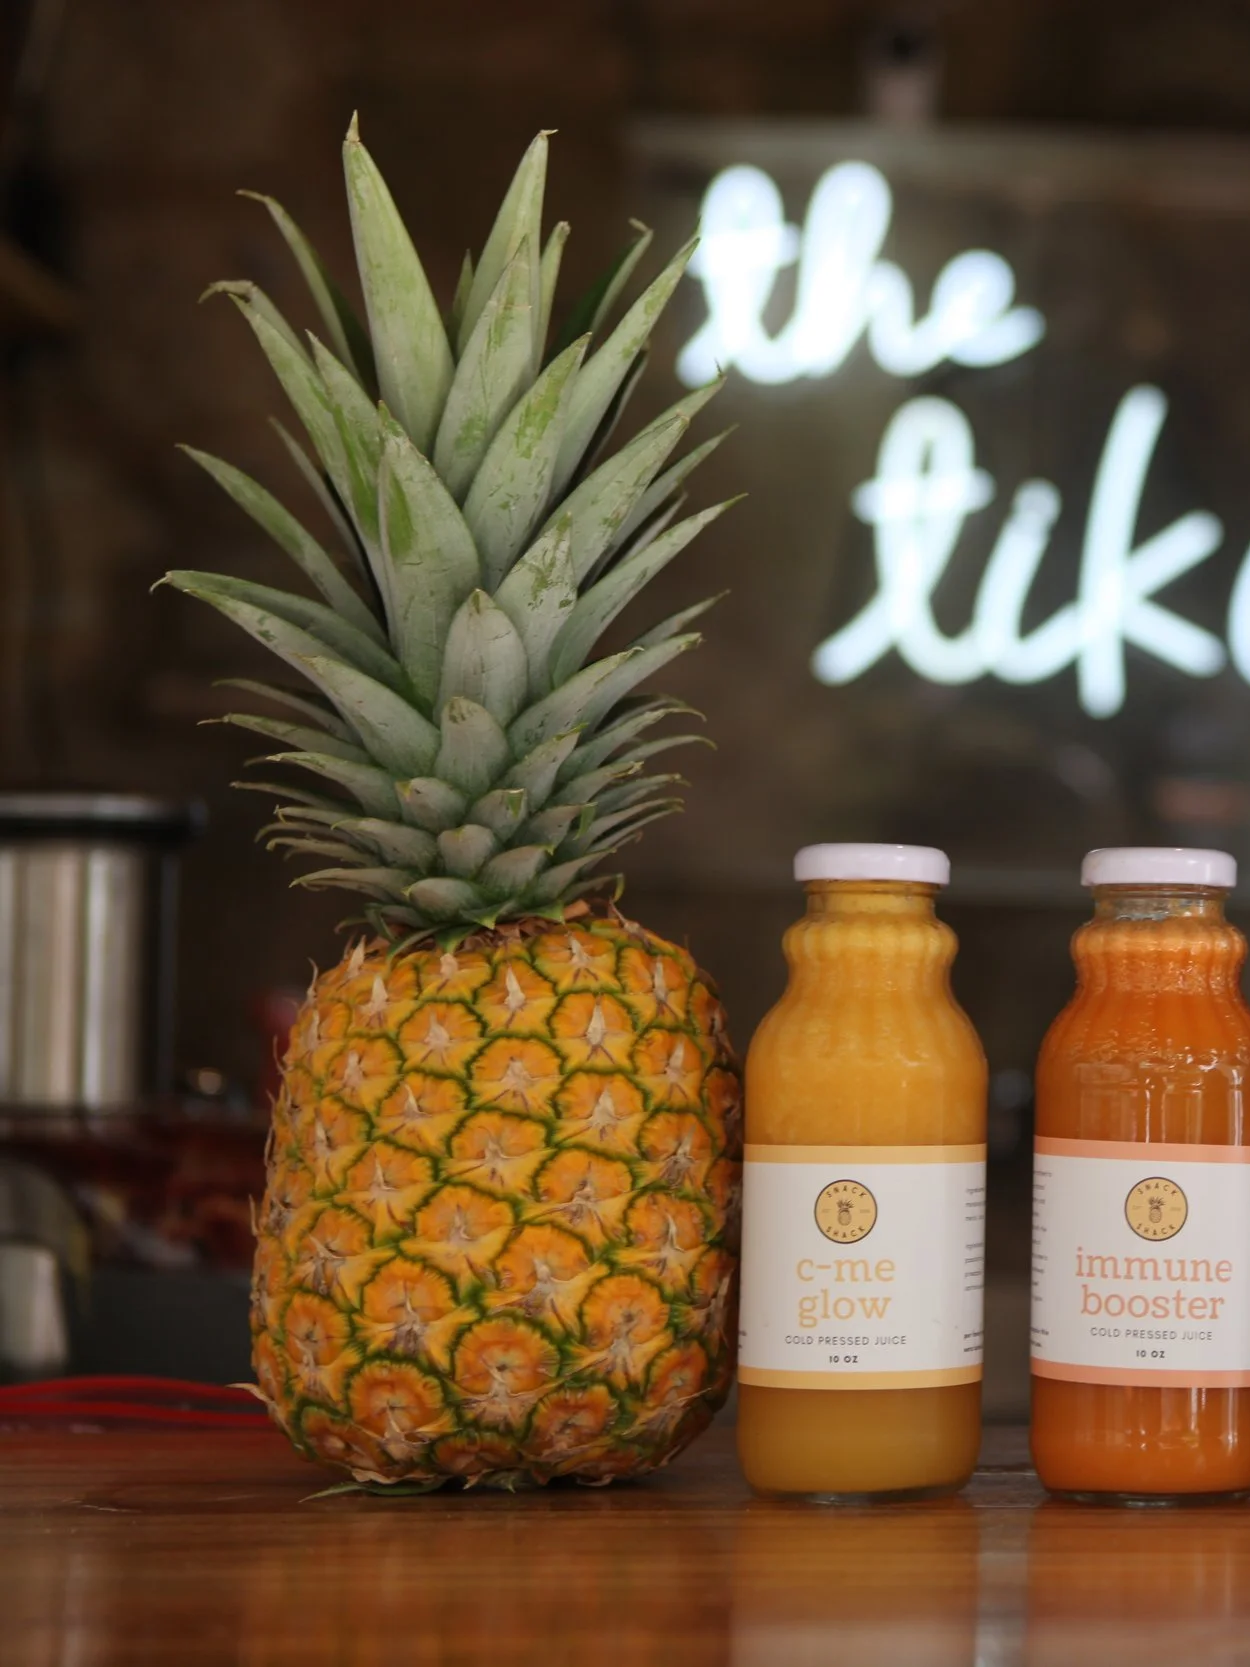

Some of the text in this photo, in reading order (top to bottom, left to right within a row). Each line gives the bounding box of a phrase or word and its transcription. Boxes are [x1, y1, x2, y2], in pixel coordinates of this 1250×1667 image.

[677, 160, 1045, 388] the
[826, 1185, 867, 1198] SNACK
[1137, 1182, 1178, 1196] SNACK
[796, 1257, 896, 1282] c-me
[1075, 1246, 1232, 1283] immune
[798, 1288, 892, 1328] glow
[1080, 1284, 1225, 1320] booster
[785, 1335, 906, 1346] COLD PRESSED JUICE
[1090, 1327, 1212, 1341] COLD PRESSED JUICE
[828, 1355, 858, 1364] 10 OZ
[1136, 1350, 1166, 1358] 10 OZ
